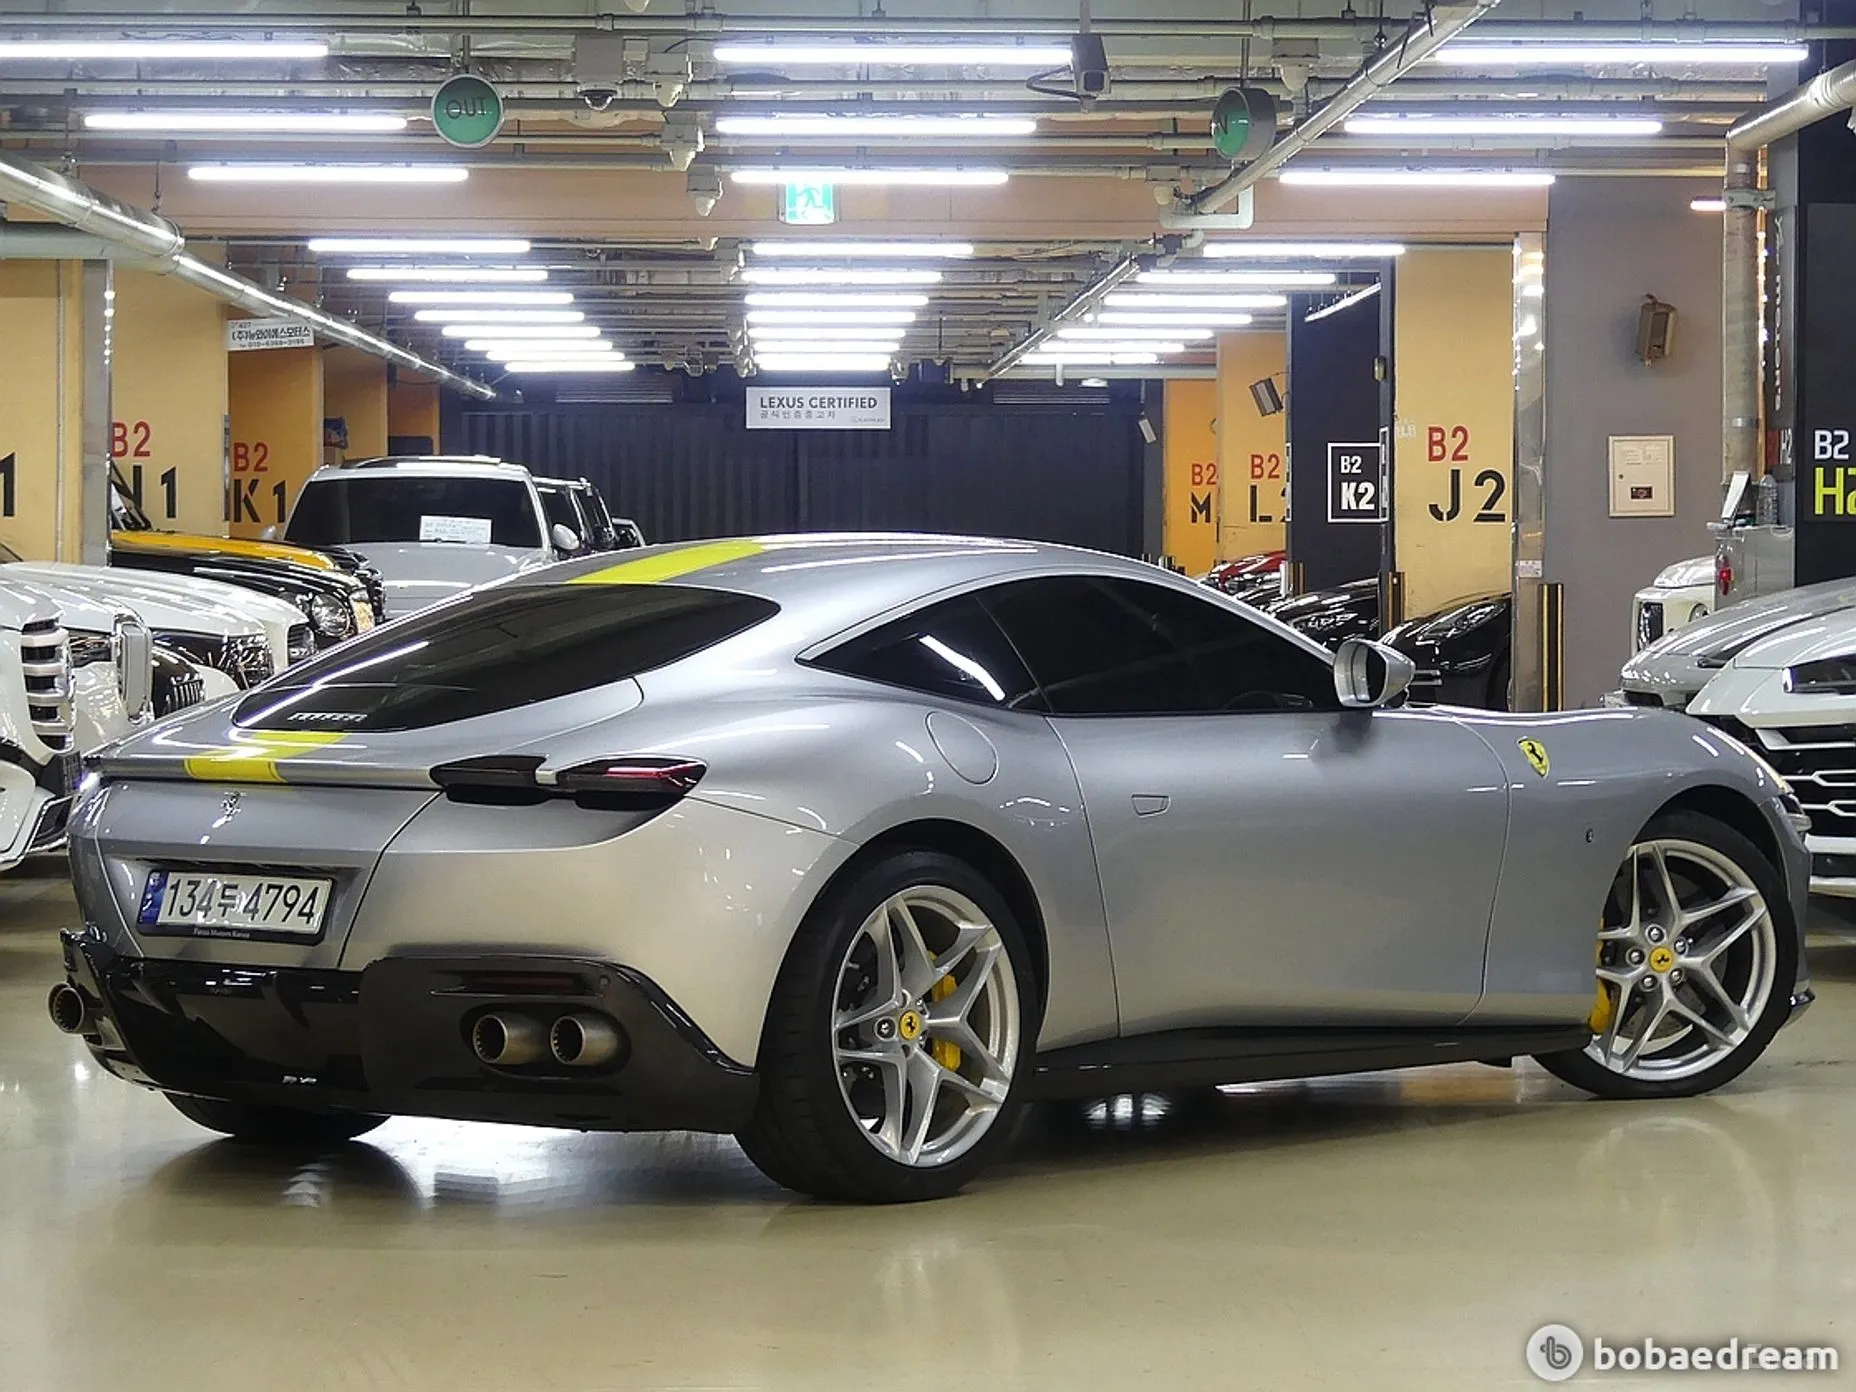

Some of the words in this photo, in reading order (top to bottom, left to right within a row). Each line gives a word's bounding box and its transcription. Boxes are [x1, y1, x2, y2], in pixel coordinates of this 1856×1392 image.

[760, 397, 804, 408] LEXUS
[808, 397, 878, 408] CERTIFIED
[111, 421, 151, 458] B2
[1427, 426, 1469, 462] B2
[1814, 429, 1850, 460] B2
[233, 442, 268, 472] B2
[1250, 454, 1280, 479] B2
[1340, 456, 1362, 473] B2
[1191, 463, 1217, 485] B2
[233, 479, 287, 523] K1
[1341, 482, 1375, 510] K2
[1428, 468, 1506, 522] J2
